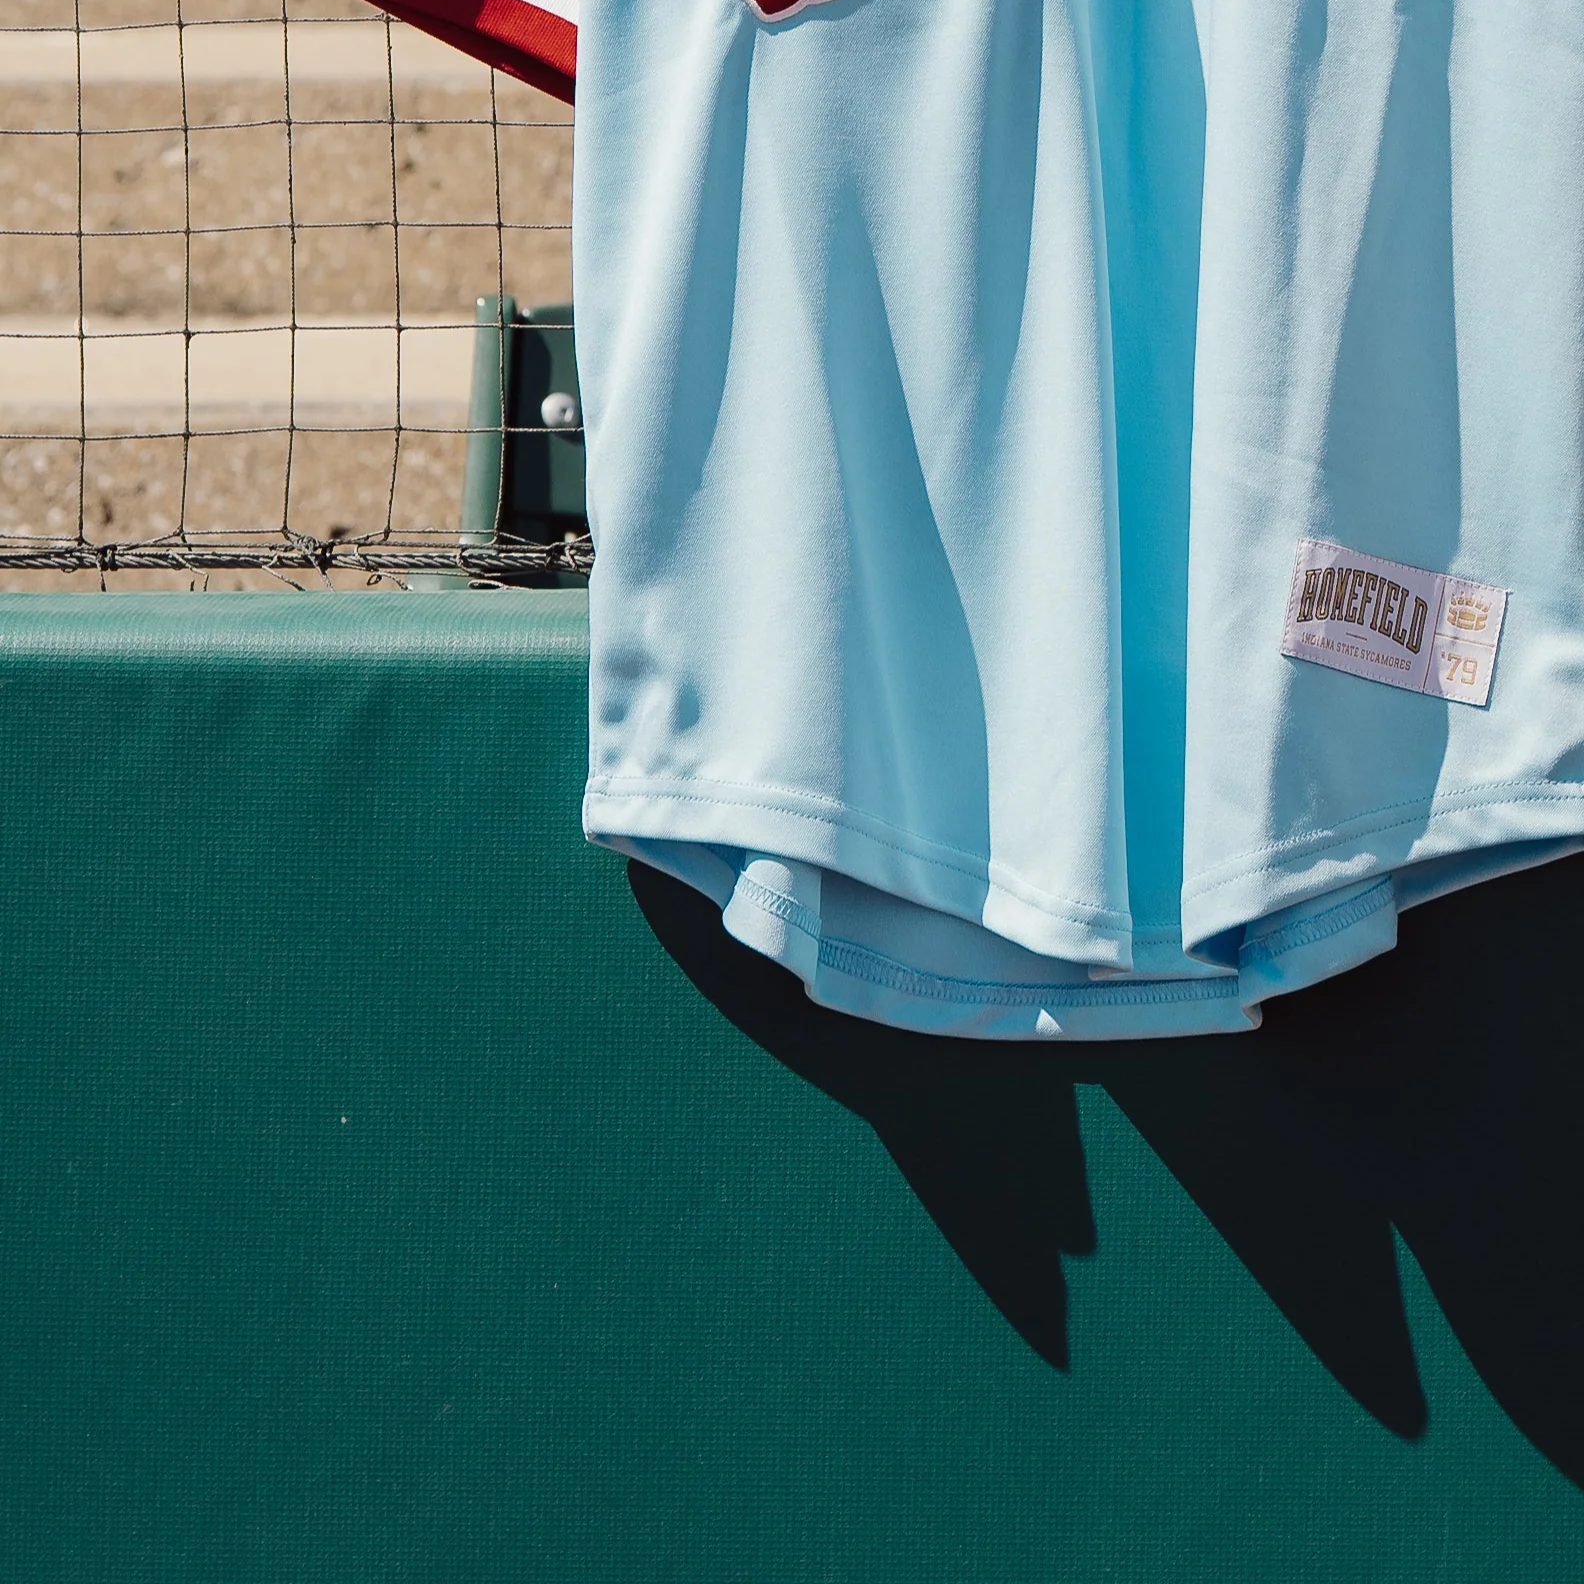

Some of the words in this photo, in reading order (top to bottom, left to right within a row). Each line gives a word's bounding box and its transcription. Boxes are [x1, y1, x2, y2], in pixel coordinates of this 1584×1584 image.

[1296, 567, 1429, 655] HOMEFIELD
[1301, 631, 1335, 653] INDIANA
[1336, 641, 1359, 658] STATE
[1360, 646, 1412, 671] SYCAMORES
